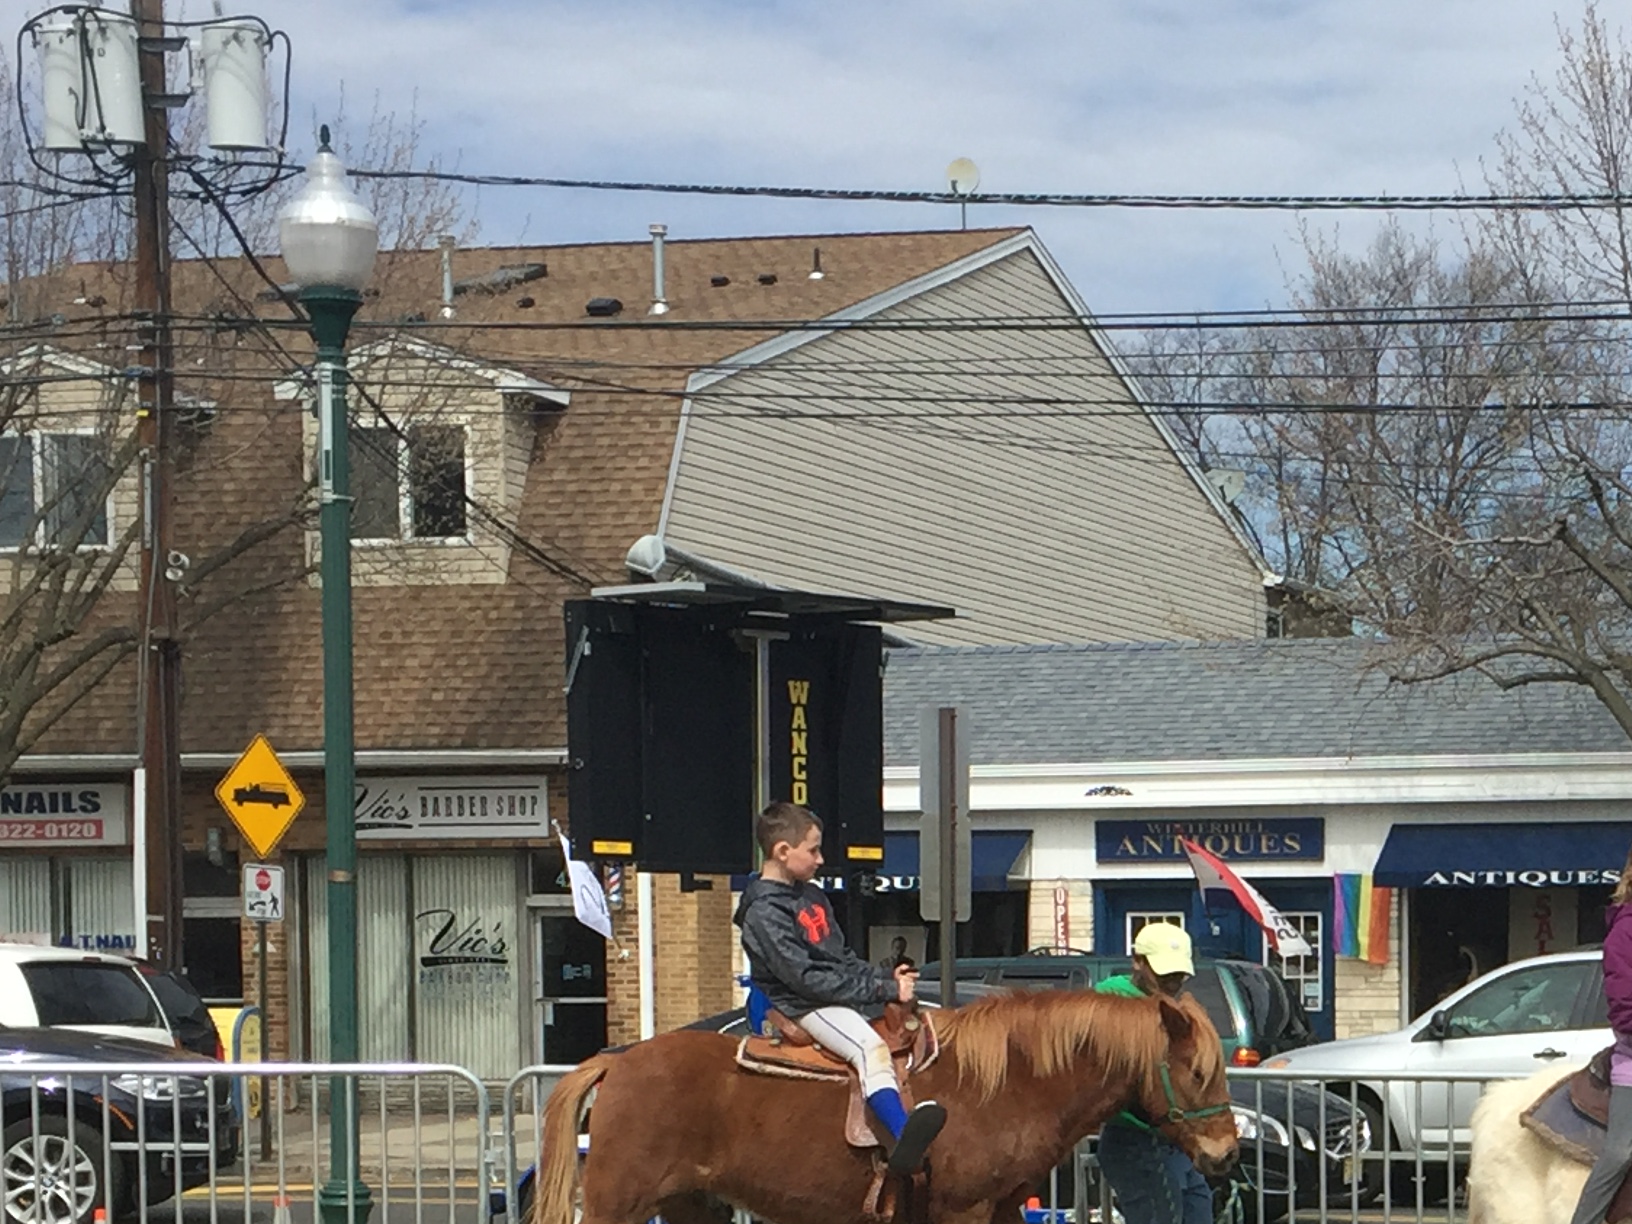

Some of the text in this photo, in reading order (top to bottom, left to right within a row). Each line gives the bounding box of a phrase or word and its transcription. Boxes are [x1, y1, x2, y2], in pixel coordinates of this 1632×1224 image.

[787, 680, 810, 805] WANCO
[1, 790, 102, 815] NAILS
[420, 795, 488, 817] BARBER
[496, 795, 538, 817] SHOP
[1423, 870, 1621, 887] ANTIQUES
[415, 909, 510, 954] Vic's
